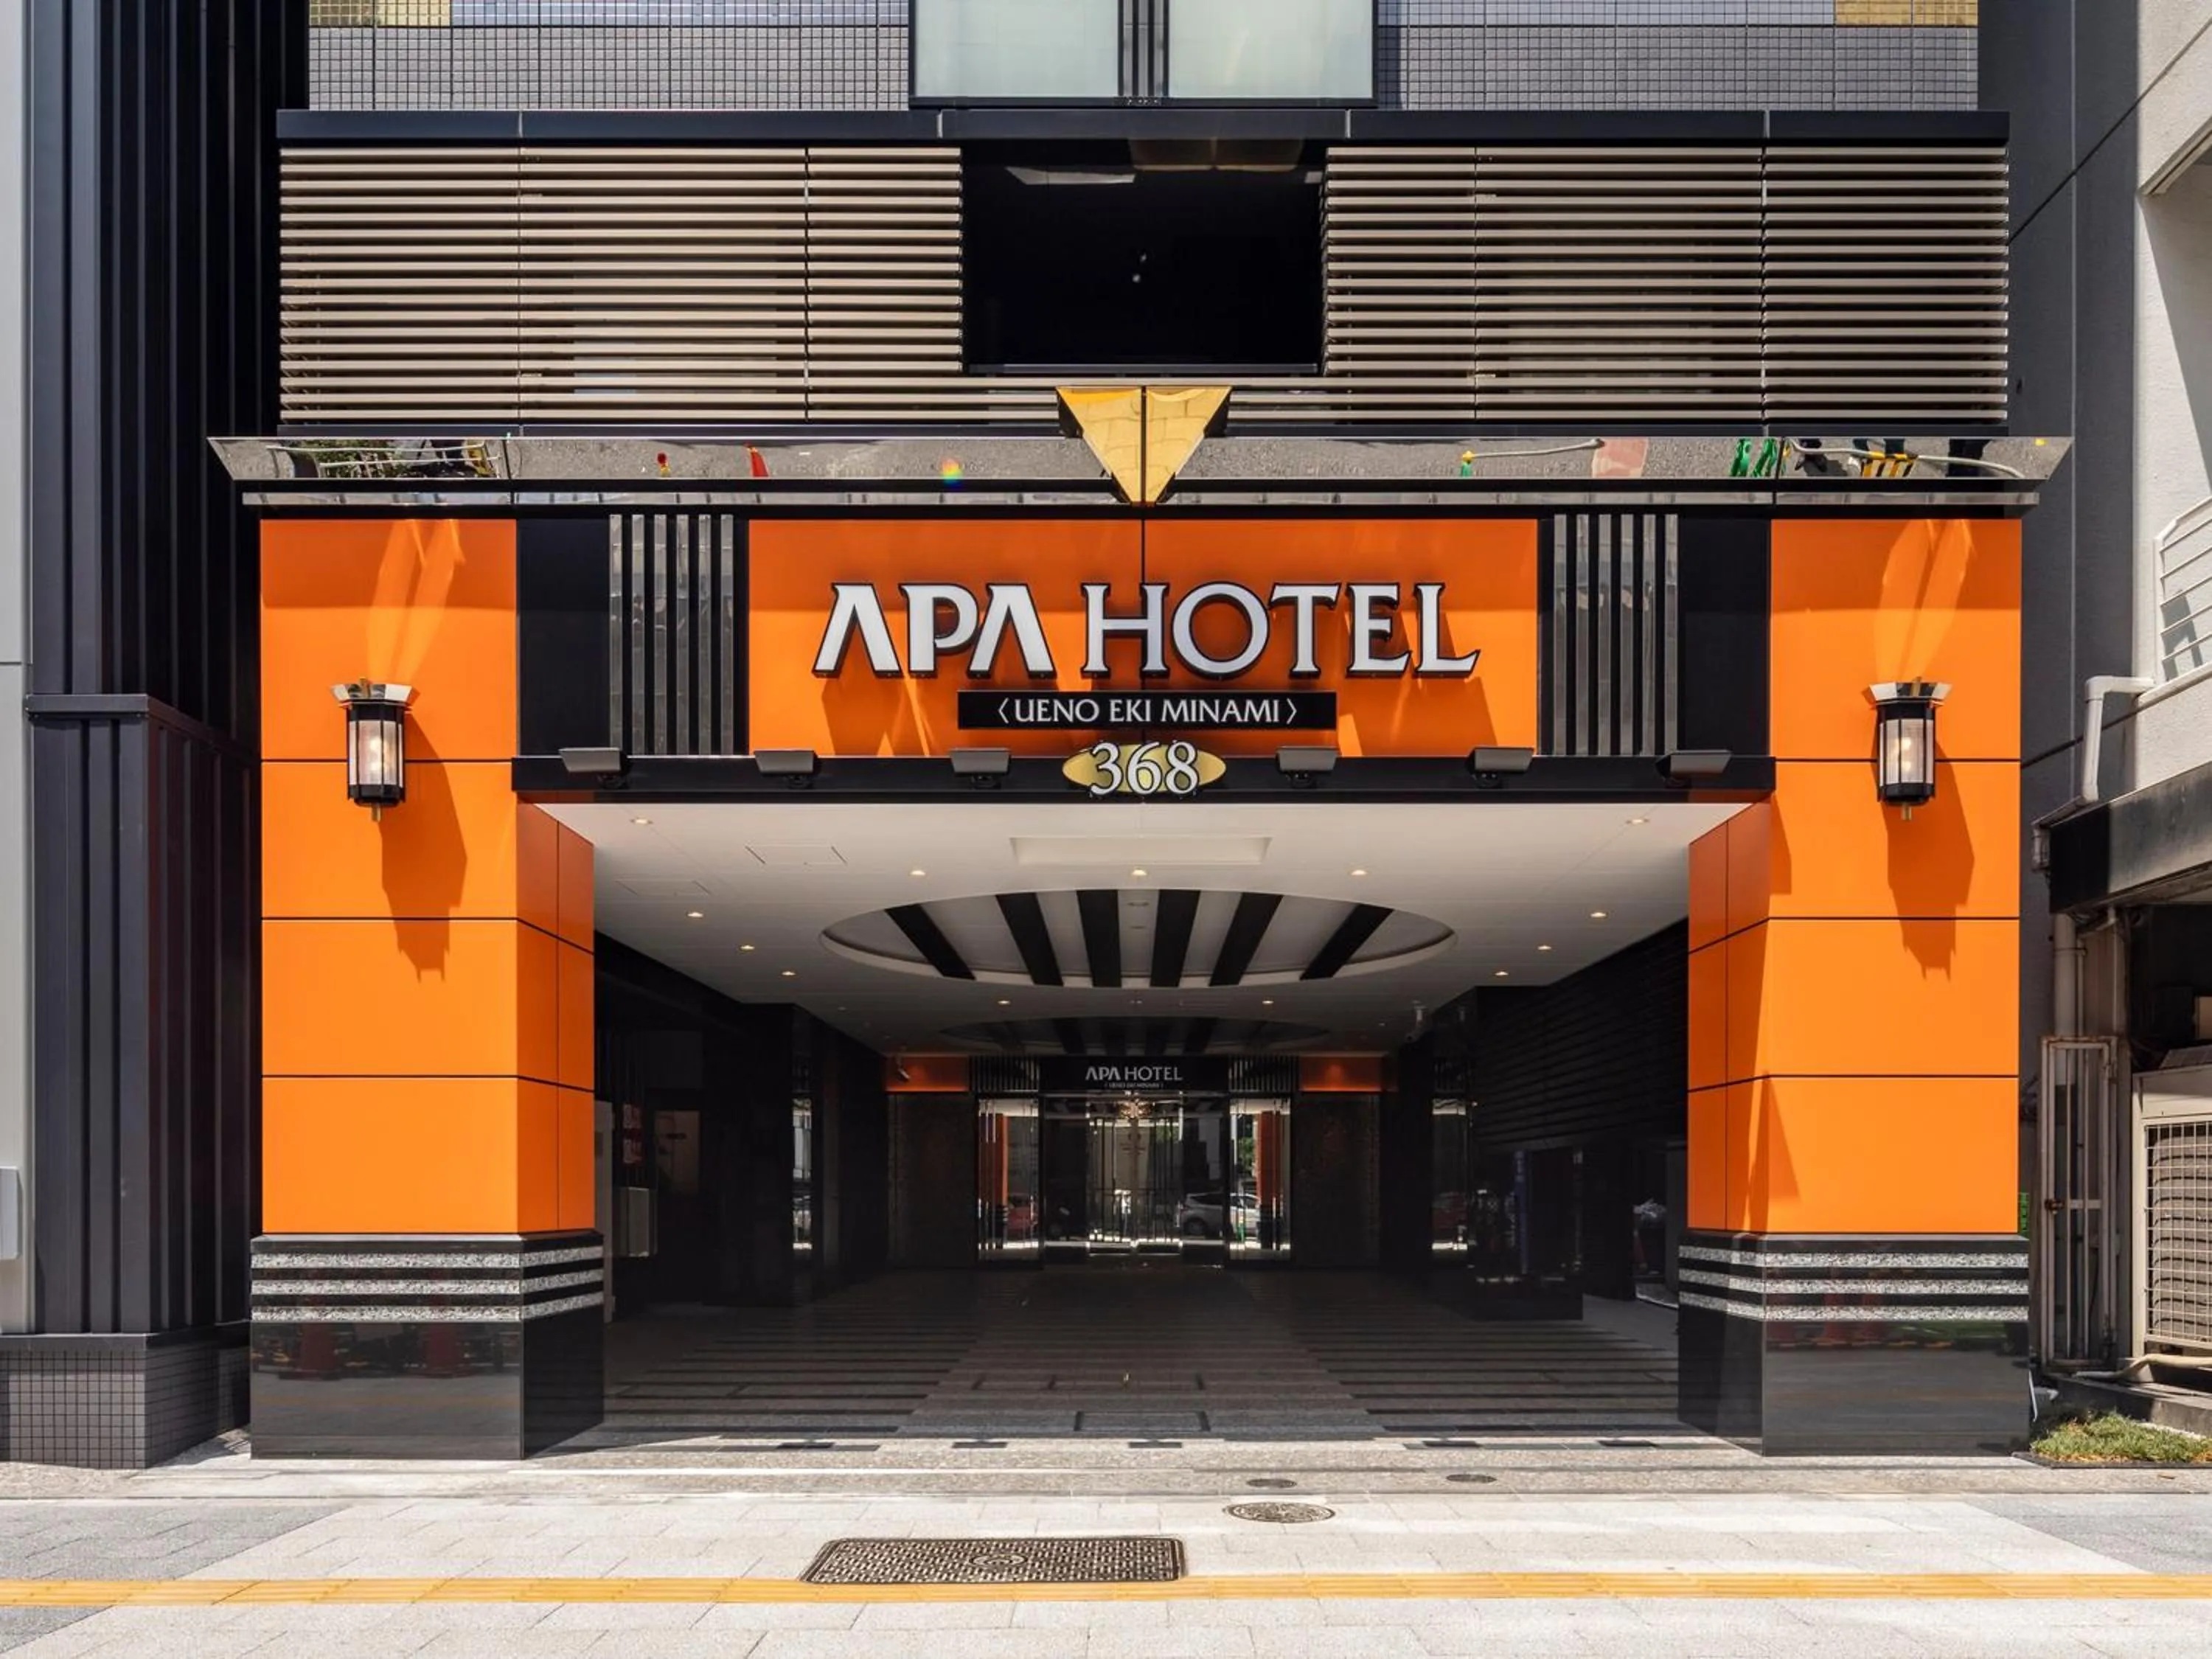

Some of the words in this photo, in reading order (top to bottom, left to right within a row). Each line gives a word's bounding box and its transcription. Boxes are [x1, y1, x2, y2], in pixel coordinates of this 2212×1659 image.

[813, 582, 1057, 678] APA
[1081, 582, 1481, 681] HOTEL
[1109, 700, 1152, 723] EKI
[1091, 741, 1200, 796] 368
[1085, 1067, 1121, 1081] APA
[1124, 1067, 1183, 1081] HOTEL
